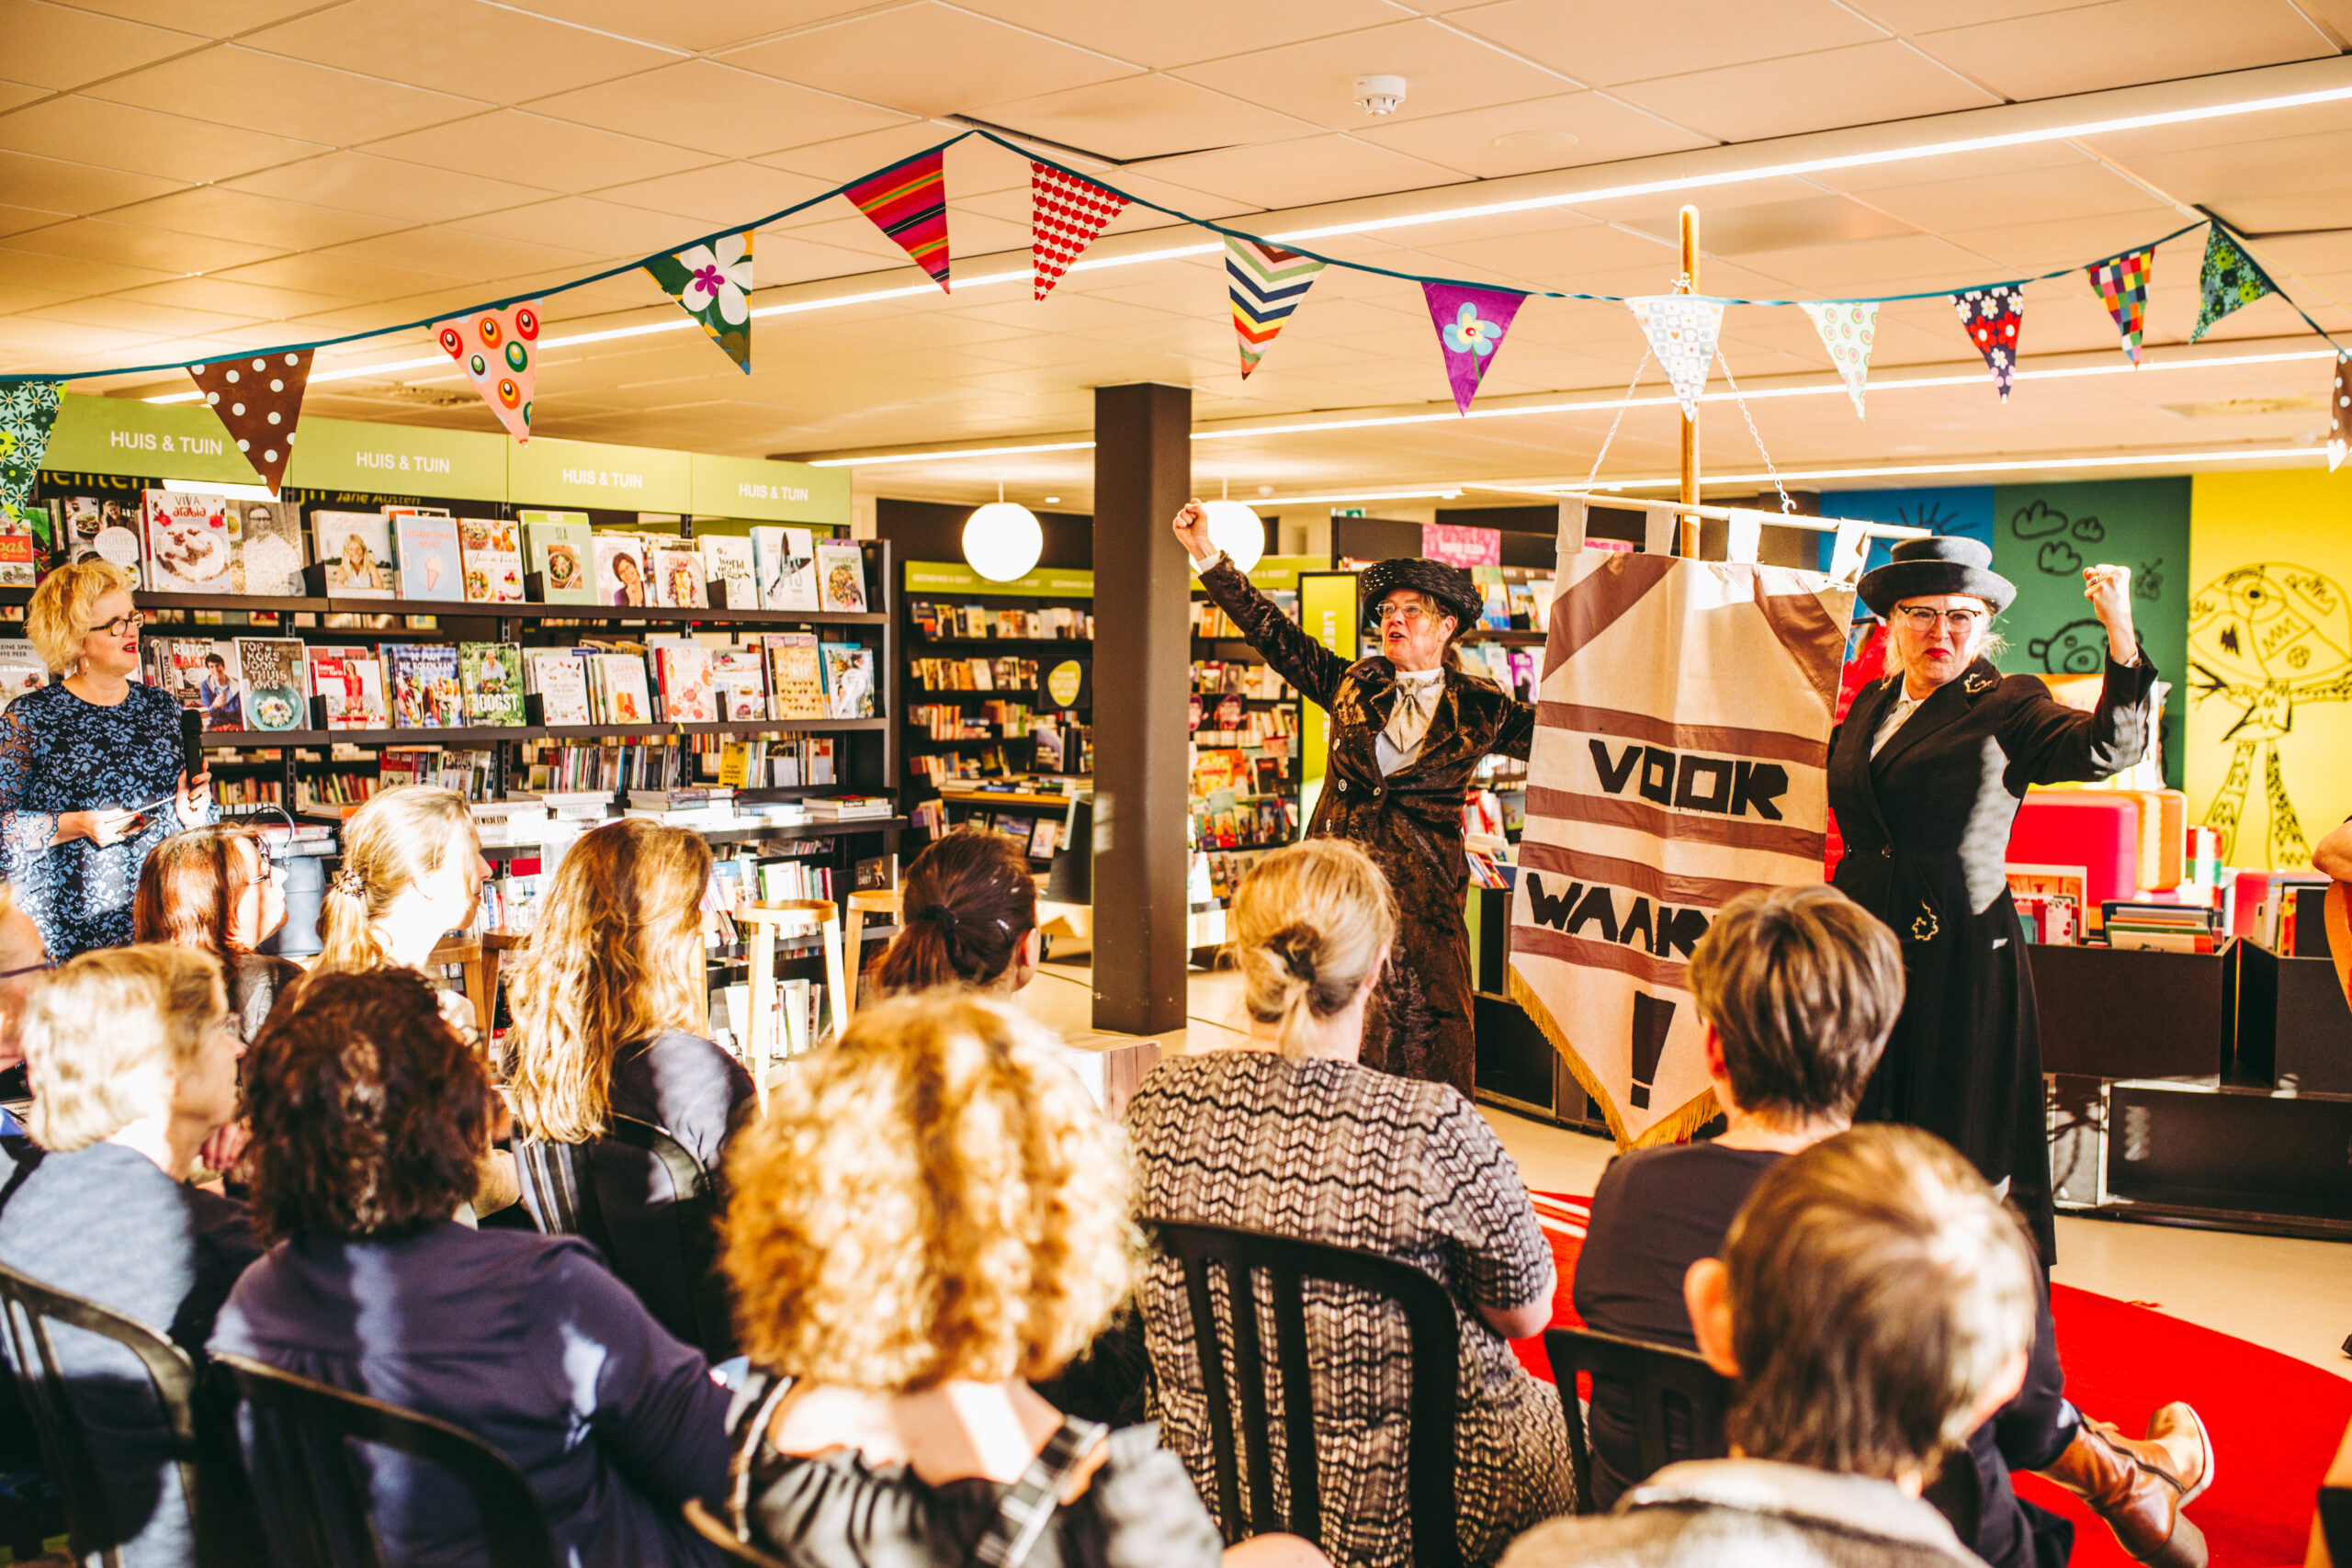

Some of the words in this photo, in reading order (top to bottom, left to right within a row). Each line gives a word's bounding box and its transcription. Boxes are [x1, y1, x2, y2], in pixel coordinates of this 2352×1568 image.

[110, 431, 157, 451] HUIS
[162, 434, 175, 452] &
[179, 436, 222, 456] TUIN
[356, 451, 394, 469] HUIS
[399, 455, 410, 470] &
[413, 457, 450, 473] TUIN
[562, 468, 595, 486] HUIS
[599, 470, 608, 487] &
[611, 471, 643, 489] TUIN
[175, 495, 200, 506] VIVA
[739, 482, 767, 499] HUIS
[770, 485, 778, 500] &
[781, 487, 808, 502] TUIN
[242, 642, 265, 653] TOP
[247, 652, 280, 662] KOKS
[164, 655, 173, 686] RUTGER
[243, 660, 277, 671] VOOR
[249, 671, 288, 681] THUIS
[1589, 739, 1789, 820] VOOR
[1526, 872, 1716, 962] WAAR
[1630, 990, 1676, 1111] !
